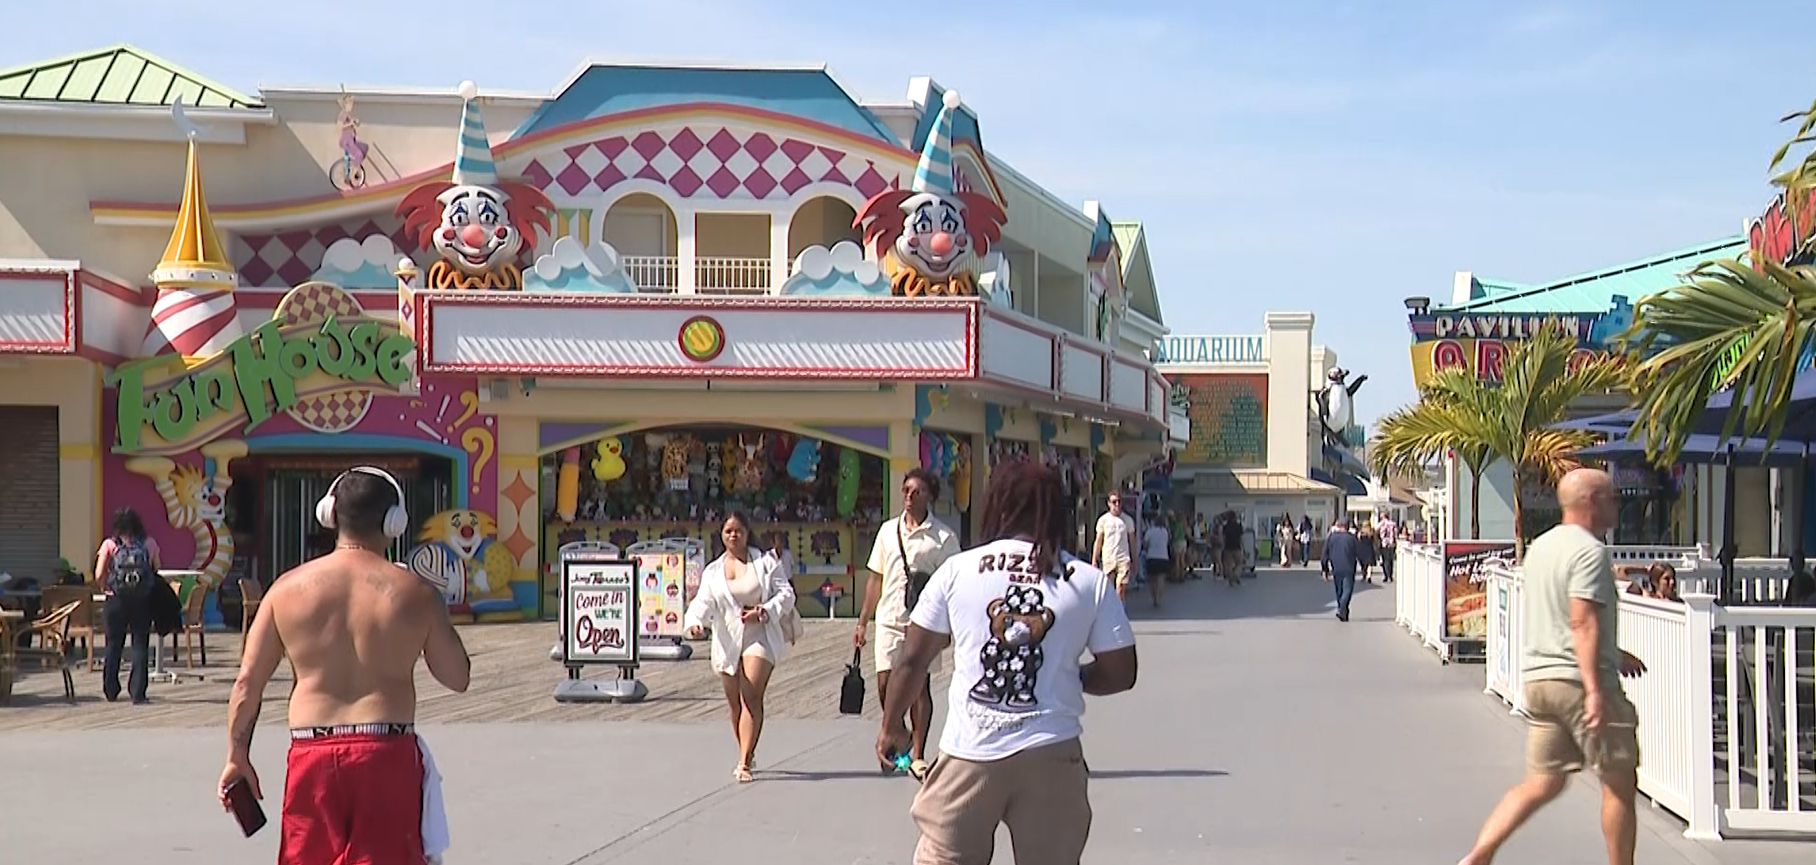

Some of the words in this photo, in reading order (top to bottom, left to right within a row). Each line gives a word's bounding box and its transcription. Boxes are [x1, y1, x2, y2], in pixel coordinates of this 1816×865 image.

[1155, 336, 1262, 363] AQUARIUM
[1450, 563, 1471, 576] Hot
[576, 592, 609, 611] Come
[576, 615, 625, 655] Open
